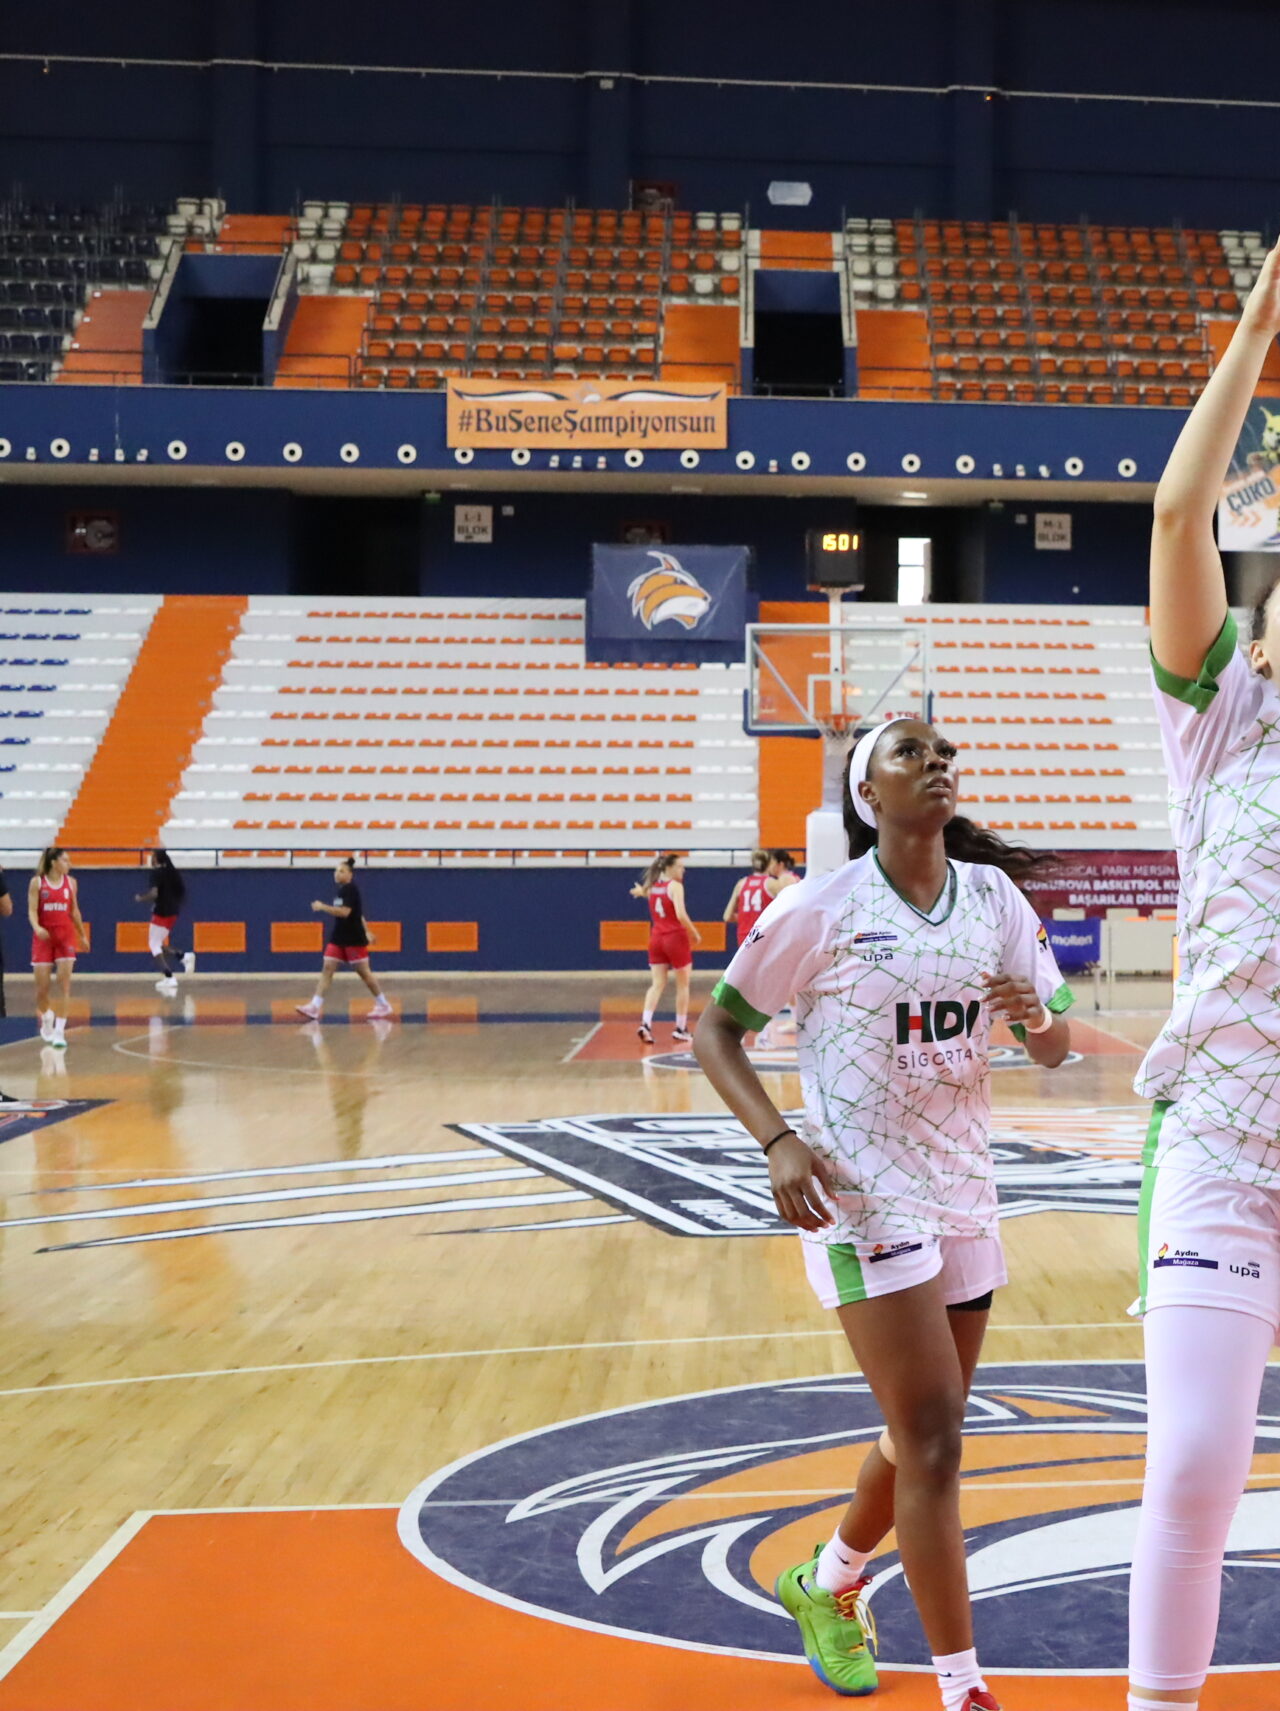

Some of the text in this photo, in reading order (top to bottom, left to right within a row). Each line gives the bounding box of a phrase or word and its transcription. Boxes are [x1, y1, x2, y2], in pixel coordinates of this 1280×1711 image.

[458, 408, 716, 439] #BuSeneŞampiyonsun
[1226, 477, 1276, 516] ÇUKO
[1093, 880, 1162, 891] BASKETBOL
[743, 889, 762, 912] 14
[1051, 935, 1093, 947] molten
[863, 952, 893, 963] upa
[1174, 1249, 1199, 1257] Aydın
[1229, 1264, 1260, 1279] upa
